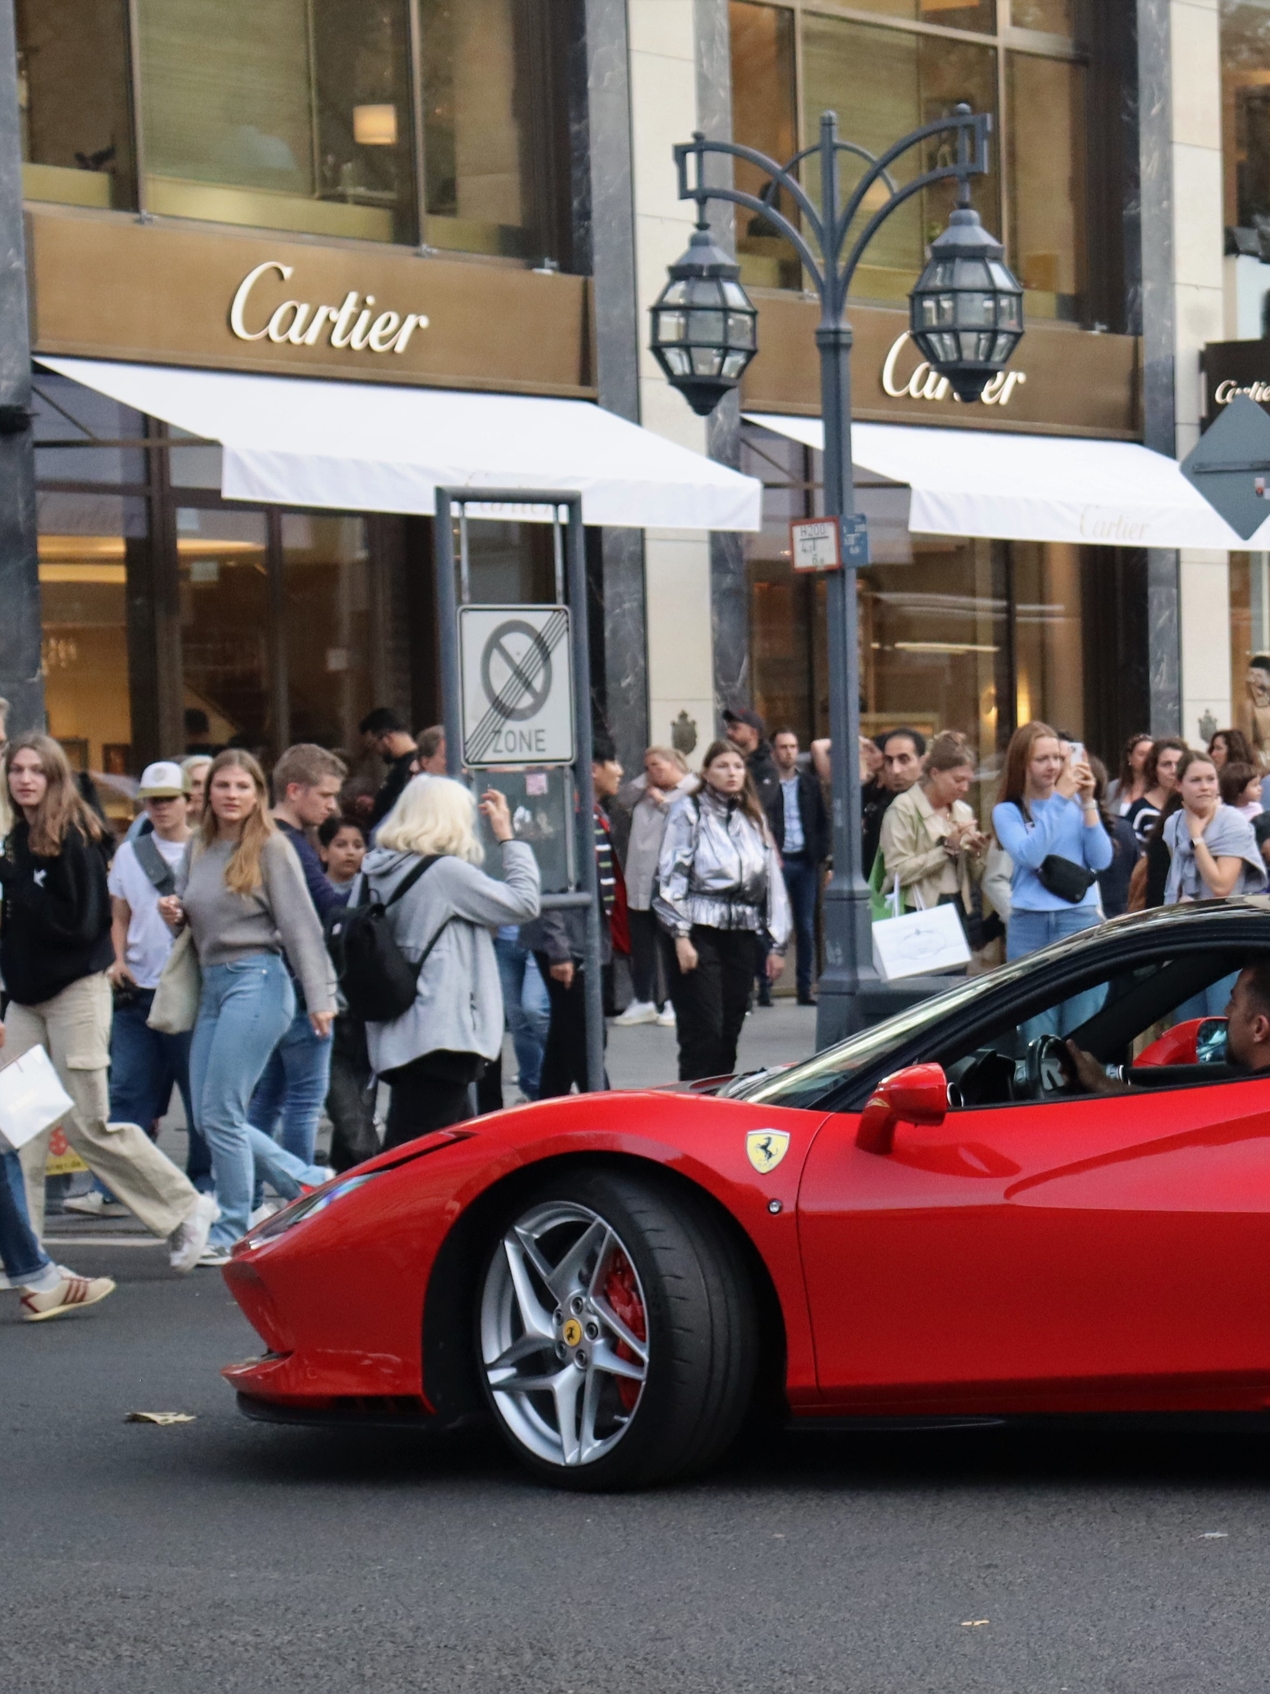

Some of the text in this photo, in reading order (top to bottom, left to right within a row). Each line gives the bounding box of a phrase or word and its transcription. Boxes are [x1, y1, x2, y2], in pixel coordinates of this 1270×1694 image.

[231, 261, 429, 354] Cartier
[1079, 503, 1150, 540] Cartier
[492, 729, 546, 754] ZONE
